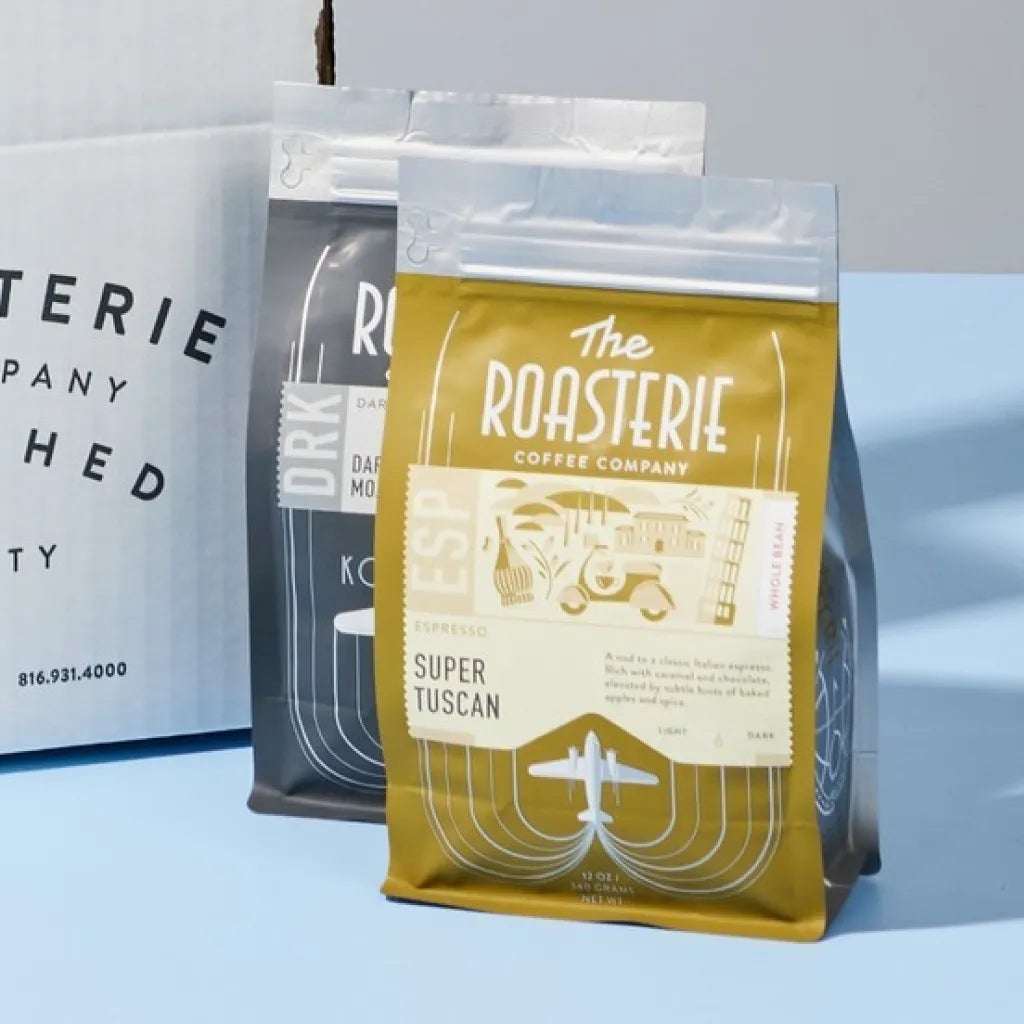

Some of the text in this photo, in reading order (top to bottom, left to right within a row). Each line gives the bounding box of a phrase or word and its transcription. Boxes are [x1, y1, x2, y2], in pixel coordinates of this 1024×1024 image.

[570, 314, 654, 361] The
[480, 359, 734, 454] ROASTERIE
[282, 392, 343, 497] DRK
[514, 450, 690, 477] COFFEE COMPANY
[411, 488, 474, 596] ESP
[768, 521, 785, 611] WHOLE BEAN
[414, 620, 488, 639] ESPRESSO
[18, 662, 127, 687] 816.931.4000
[414, 653, 486, 686] SUPER
[414, 686, 501, 721] TUSCAN
